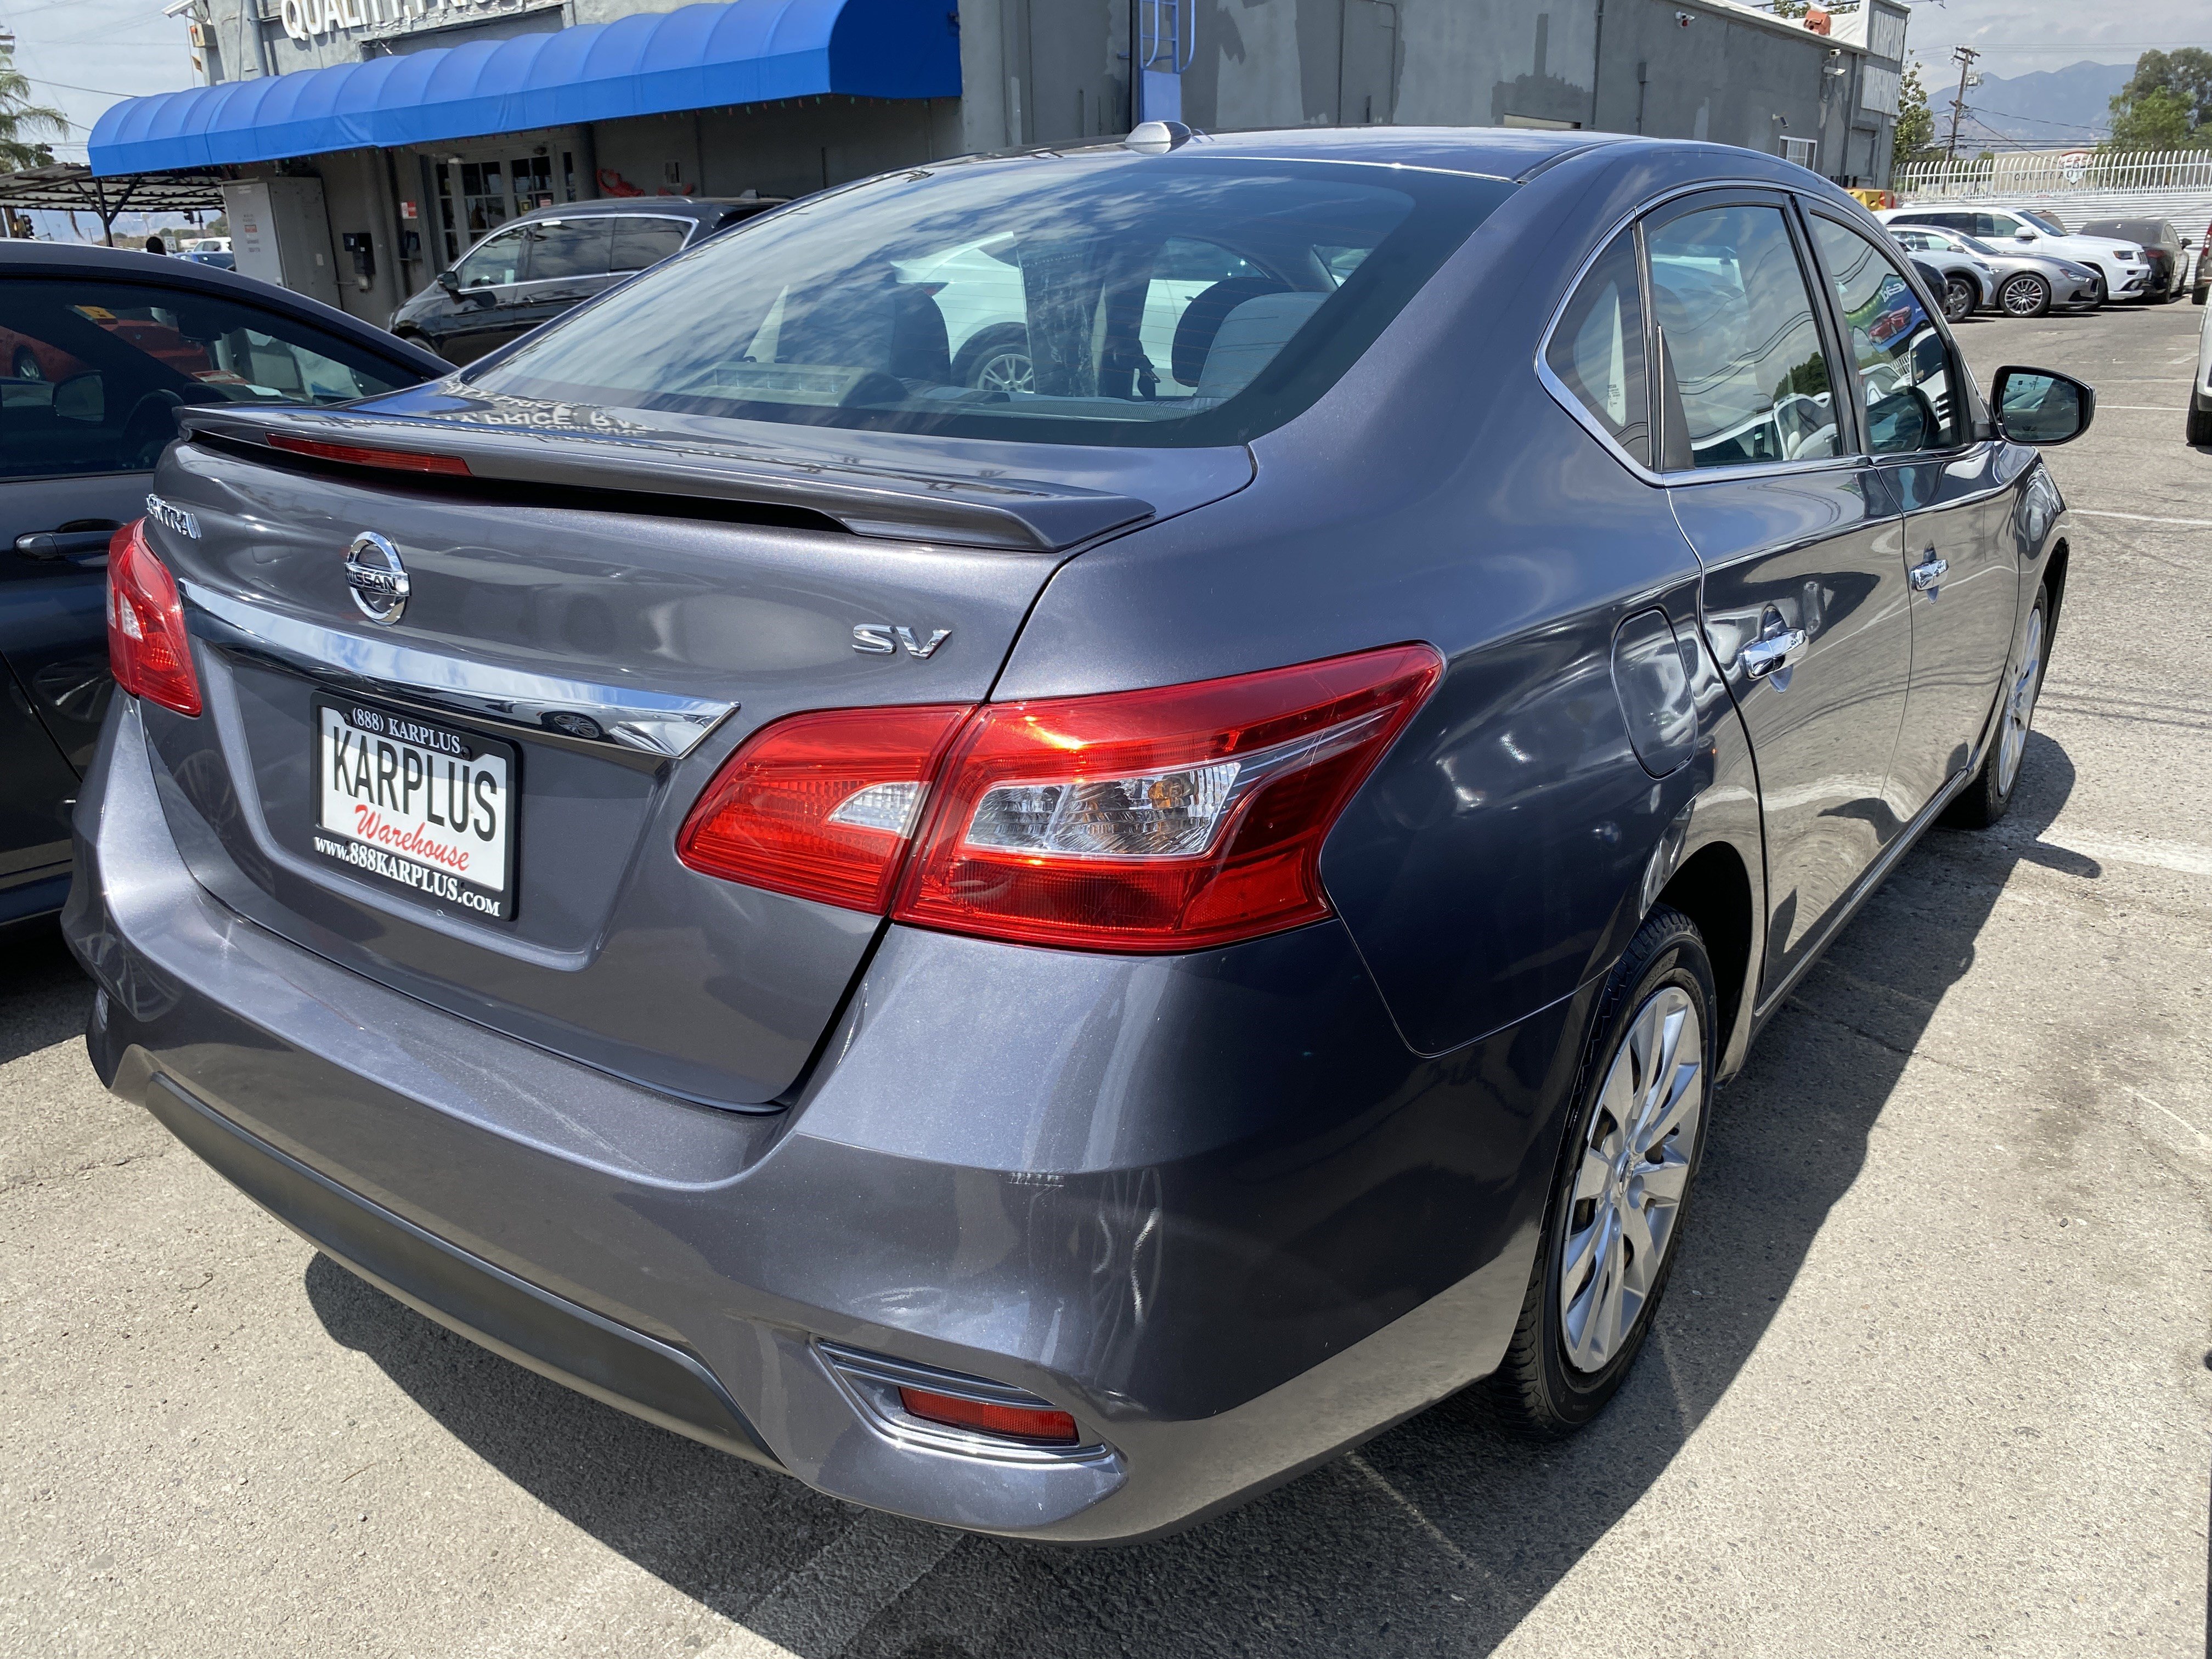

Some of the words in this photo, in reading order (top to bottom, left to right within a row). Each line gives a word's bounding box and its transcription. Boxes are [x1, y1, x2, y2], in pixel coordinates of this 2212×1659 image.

[347, 571, 397, 591] NISSAN
[851, 623, 952, 660] SV
[352, 708, 384, 732] (888)
[387, 717, 461, 754] KARPLUS
[334, 726, 498, 842] KARPLUS
[354, 804, 470, 871] Warehouse
